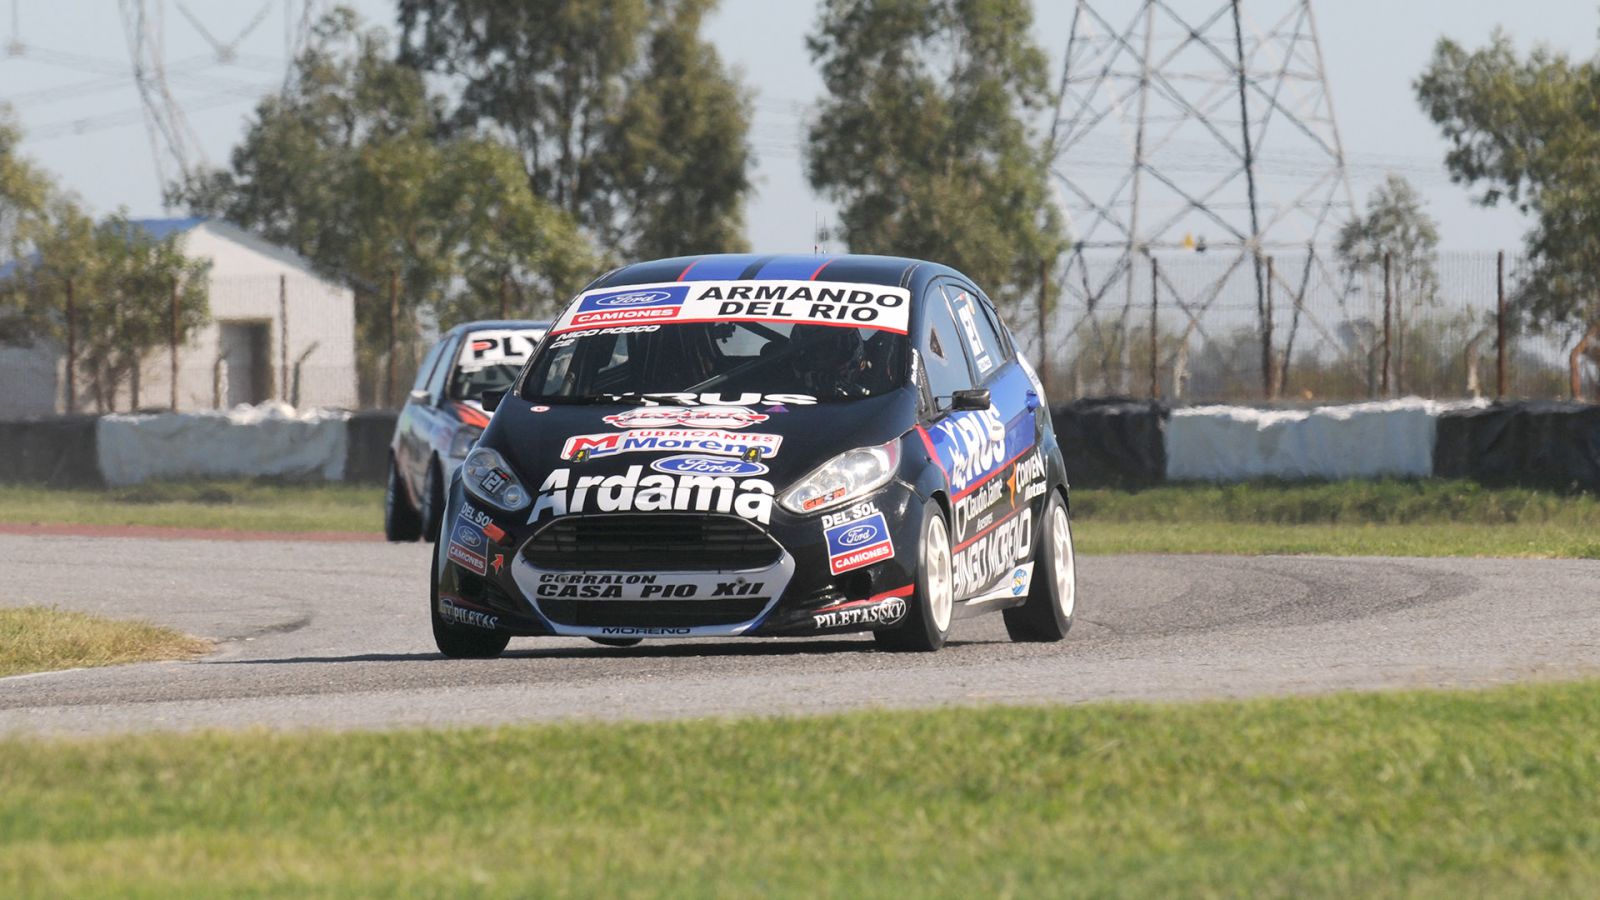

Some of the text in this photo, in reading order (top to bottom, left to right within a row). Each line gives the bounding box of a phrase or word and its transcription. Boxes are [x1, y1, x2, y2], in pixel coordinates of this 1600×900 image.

[609, 291, 656, 305] Ford
[697, 286, 904, 308] ARMANDO
[577, 309, 673, 323] CAMIONES
[718, 301, 879, 322] DEL RIO
[623, 437, 772, 455] Moreno
[628, 431, 774, 443] LUBRICANTES
[677, 459, 742, 472] Ford
[526, 465, 775, 525] Ardama
[461, 501, 475, 519] DEL
[821, 501, 879, 529] DEL SOL
[846, 527, 870, 543] Ford
[450, 546, 484, 569] CAMIONES
[835, 545, 889, 569] CAMIONES
[536, 582, 765, 598] CASA PIO XII
[601, 626, 691, 635] MORENO
